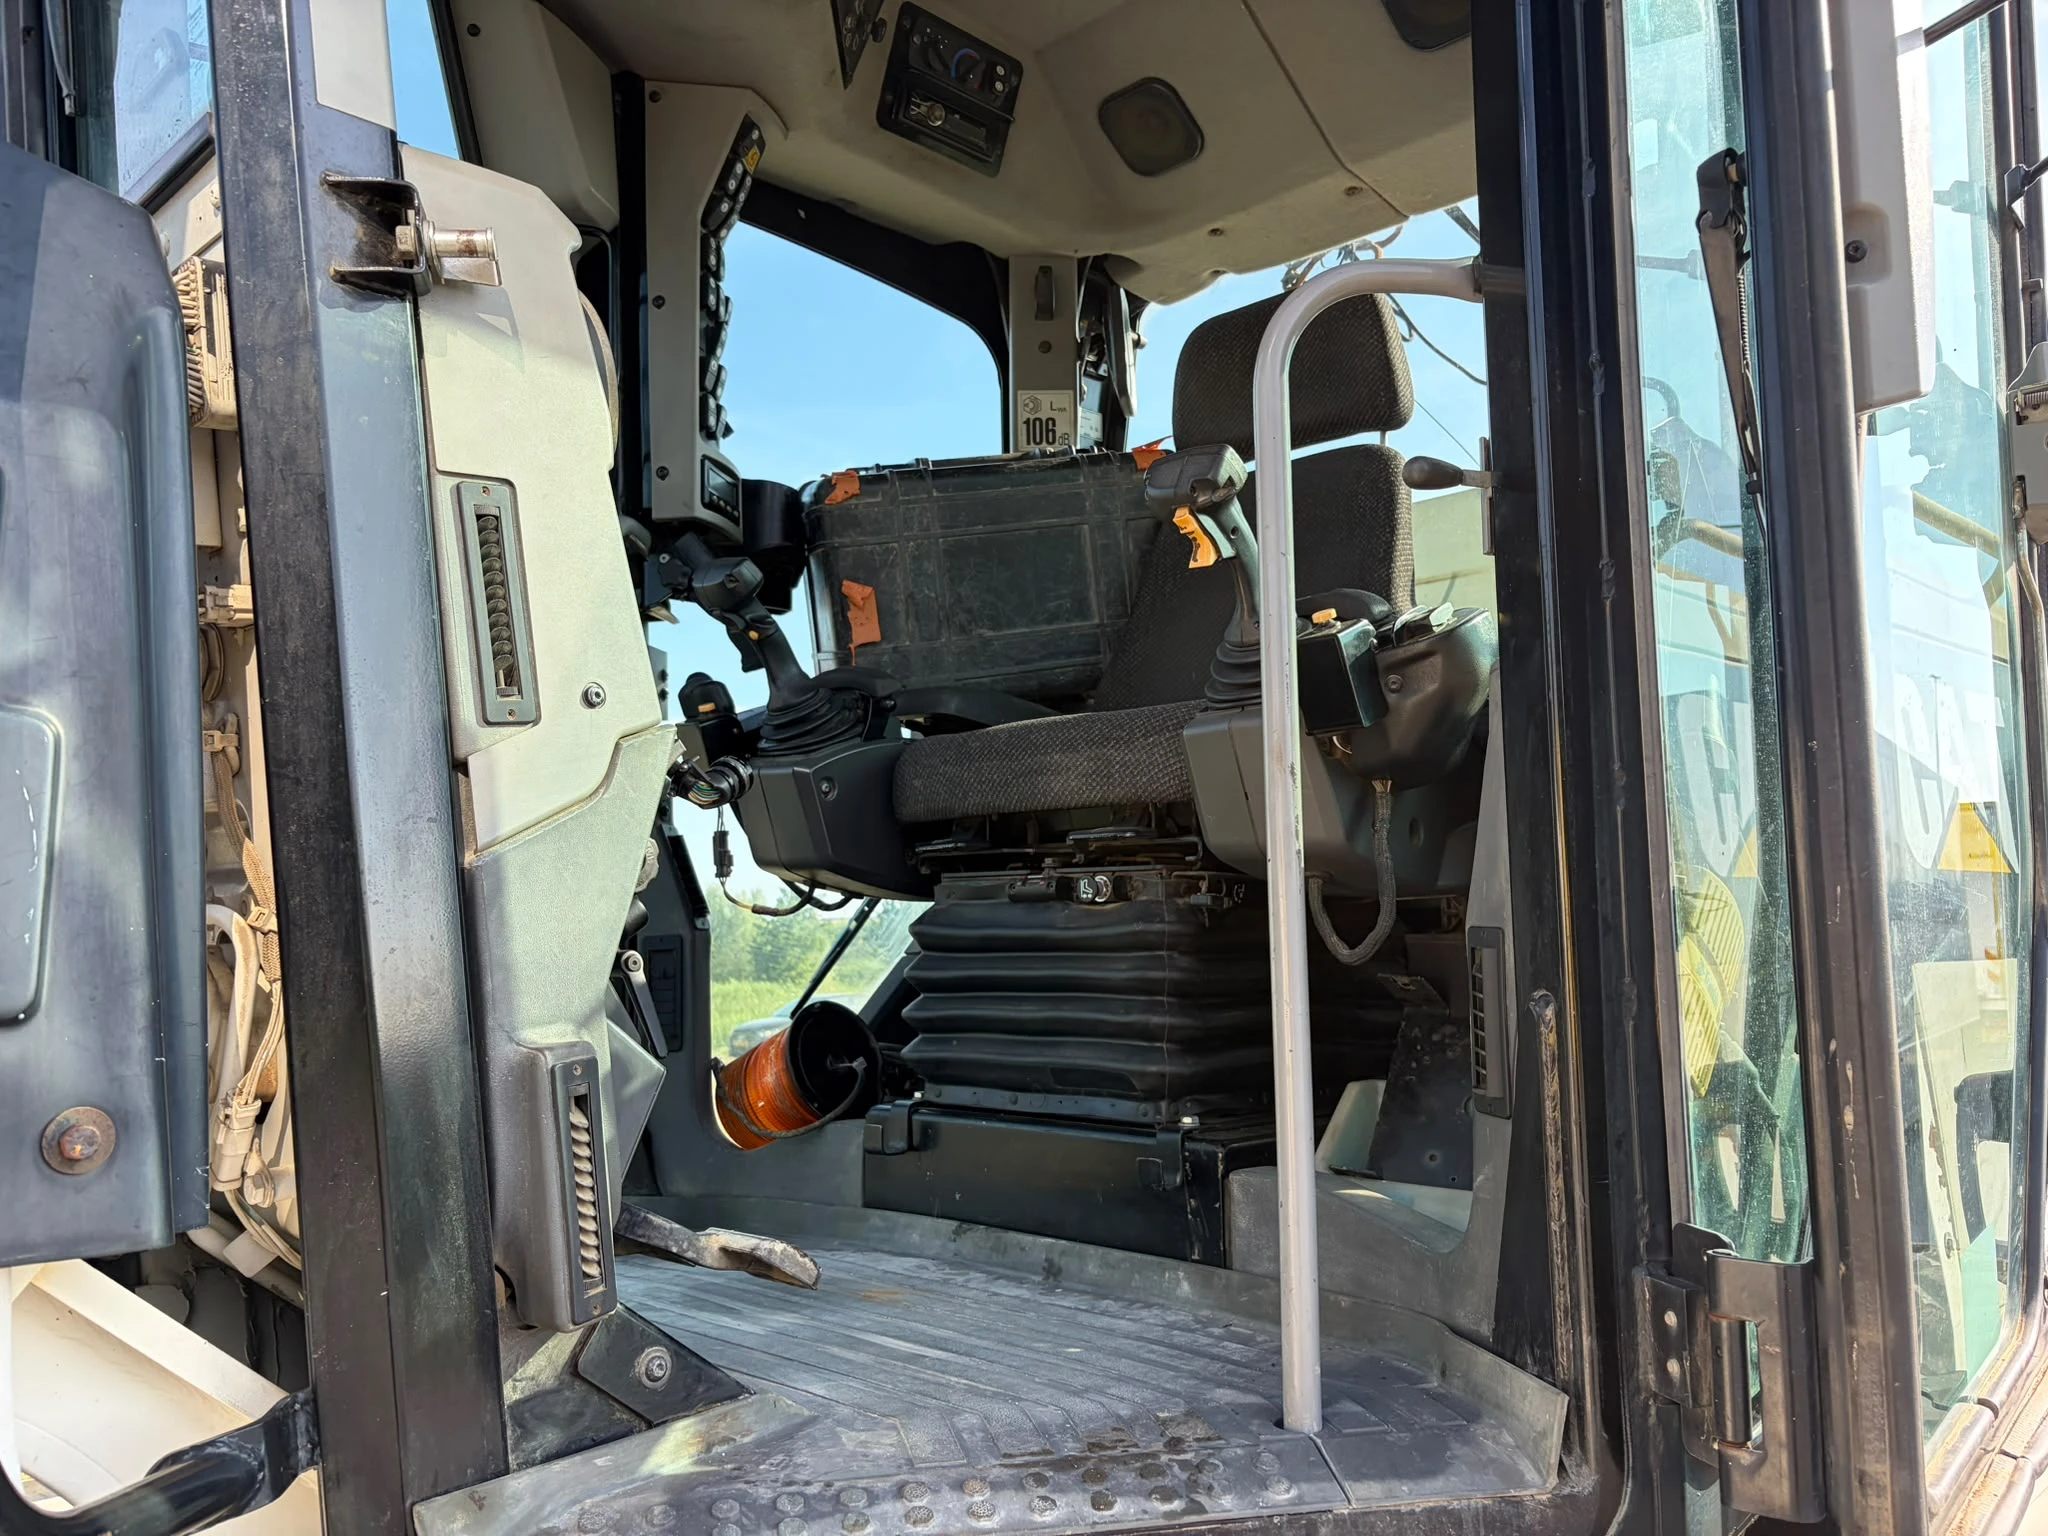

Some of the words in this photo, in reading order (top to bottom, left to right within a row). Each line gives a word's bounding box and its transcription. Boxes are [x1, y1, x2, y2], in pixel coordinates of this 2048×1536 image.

[1022, 417, 1057, 446] 106
[1058, 433, 1070, 446] dB
[1893, 671, 2019, 874] CAT
